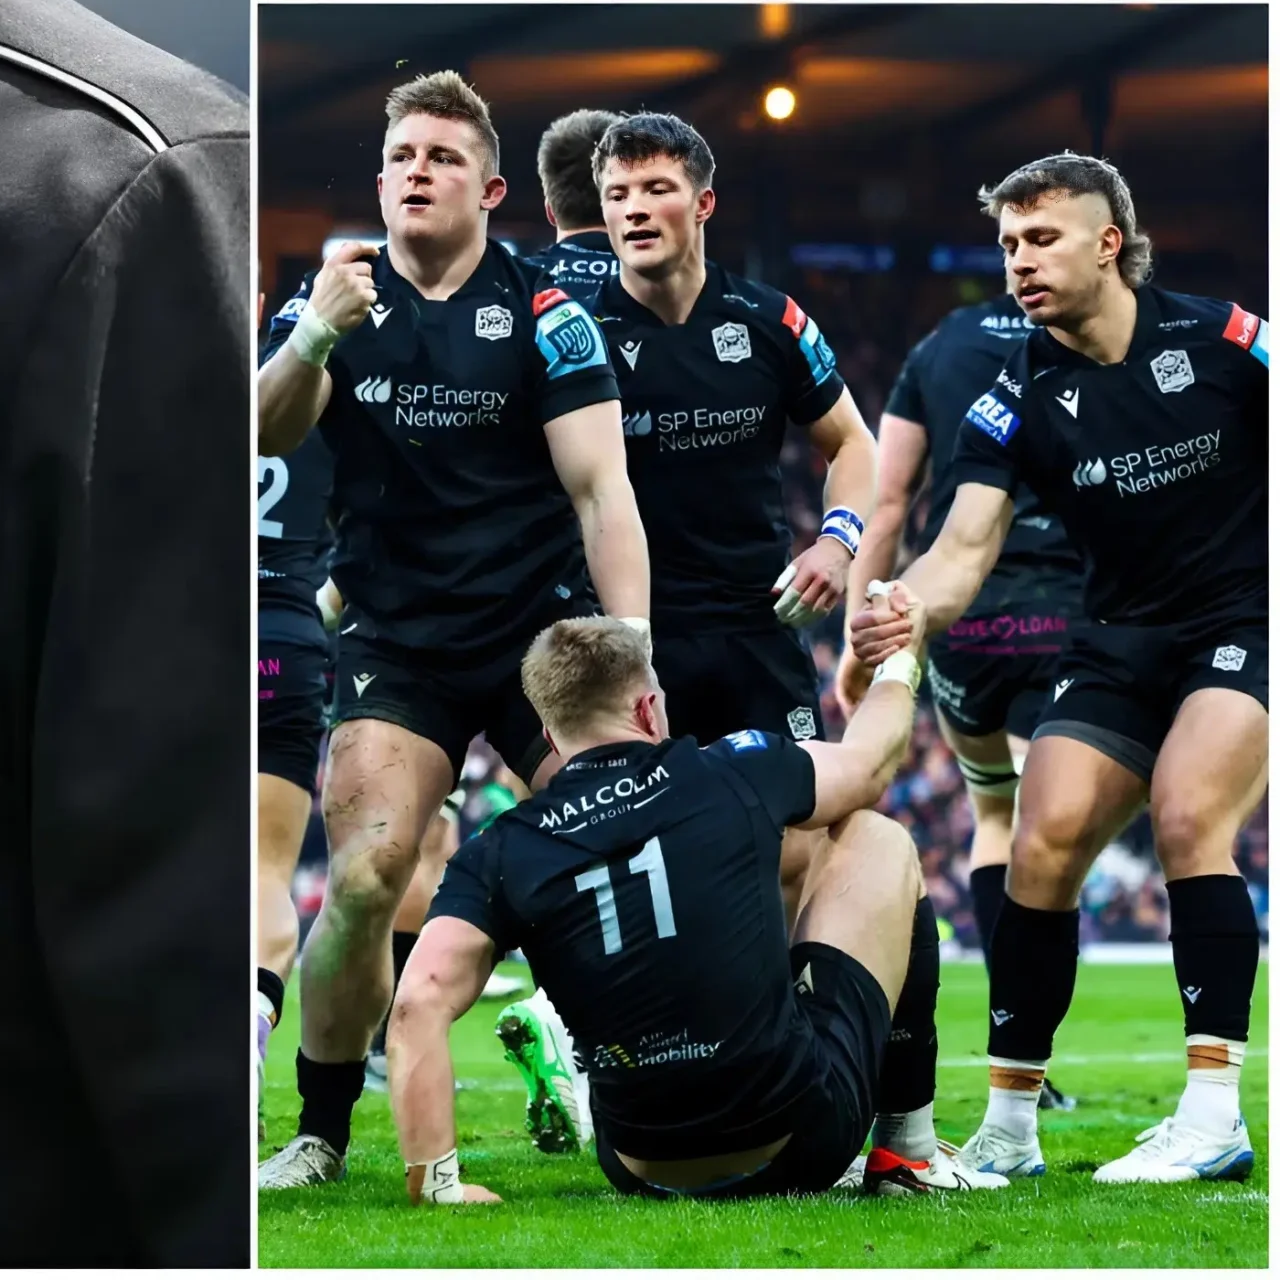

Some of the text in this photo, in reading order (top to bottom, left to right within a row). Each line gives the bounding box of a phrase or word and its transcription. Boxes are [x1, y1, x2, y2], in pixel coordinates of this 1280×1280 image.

[397, 384, 509, 410] SP Energy
[396, 406, 500, 427] Networks
[657, 405, 766, 433] SP Energy
[1111, 429, 1220, 477] SP Energy
[539, 765, 669, 828] MALCOLM
[574, 836, 676, 956] 11
